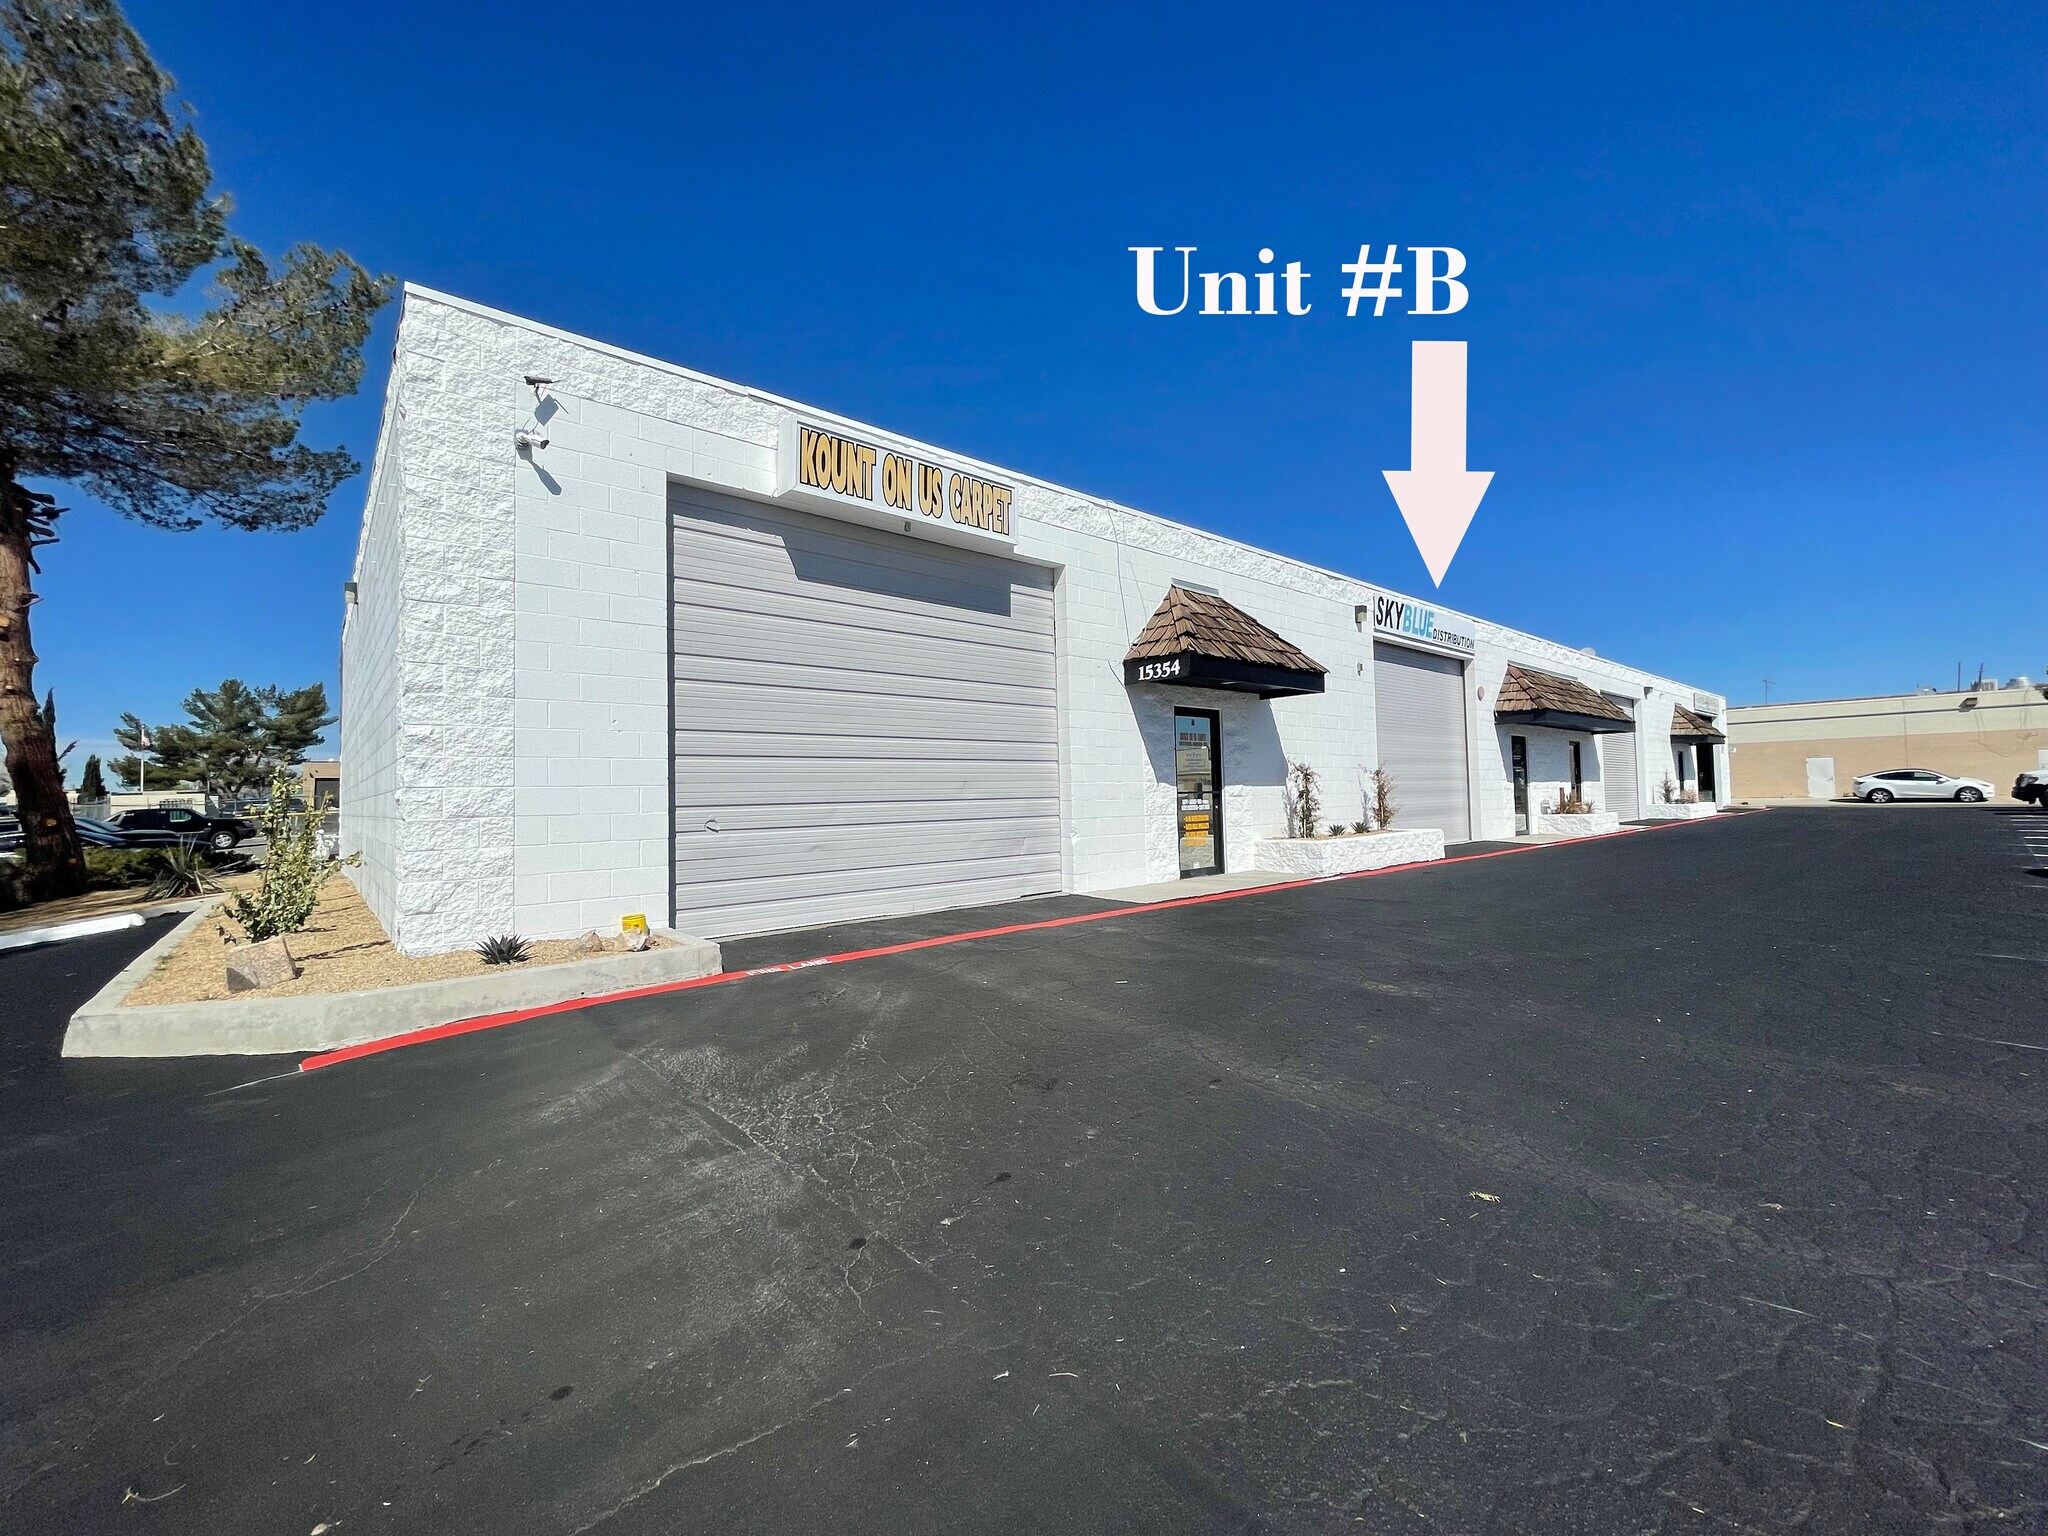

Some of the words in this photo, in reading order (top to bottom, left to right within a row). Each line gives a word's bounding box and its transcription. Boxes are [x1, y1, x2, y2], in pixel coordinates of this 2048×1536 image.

[800, 427, 876, 501] KOUNT
[882, 453, 912, 511] ON
[918, 463, 943, 518] US
[949, 473, 1012, 535] CARPET
[1432, 628, 1475, 650] DISTRIBUTION
[1137, 659, 1181, 682] 15354
